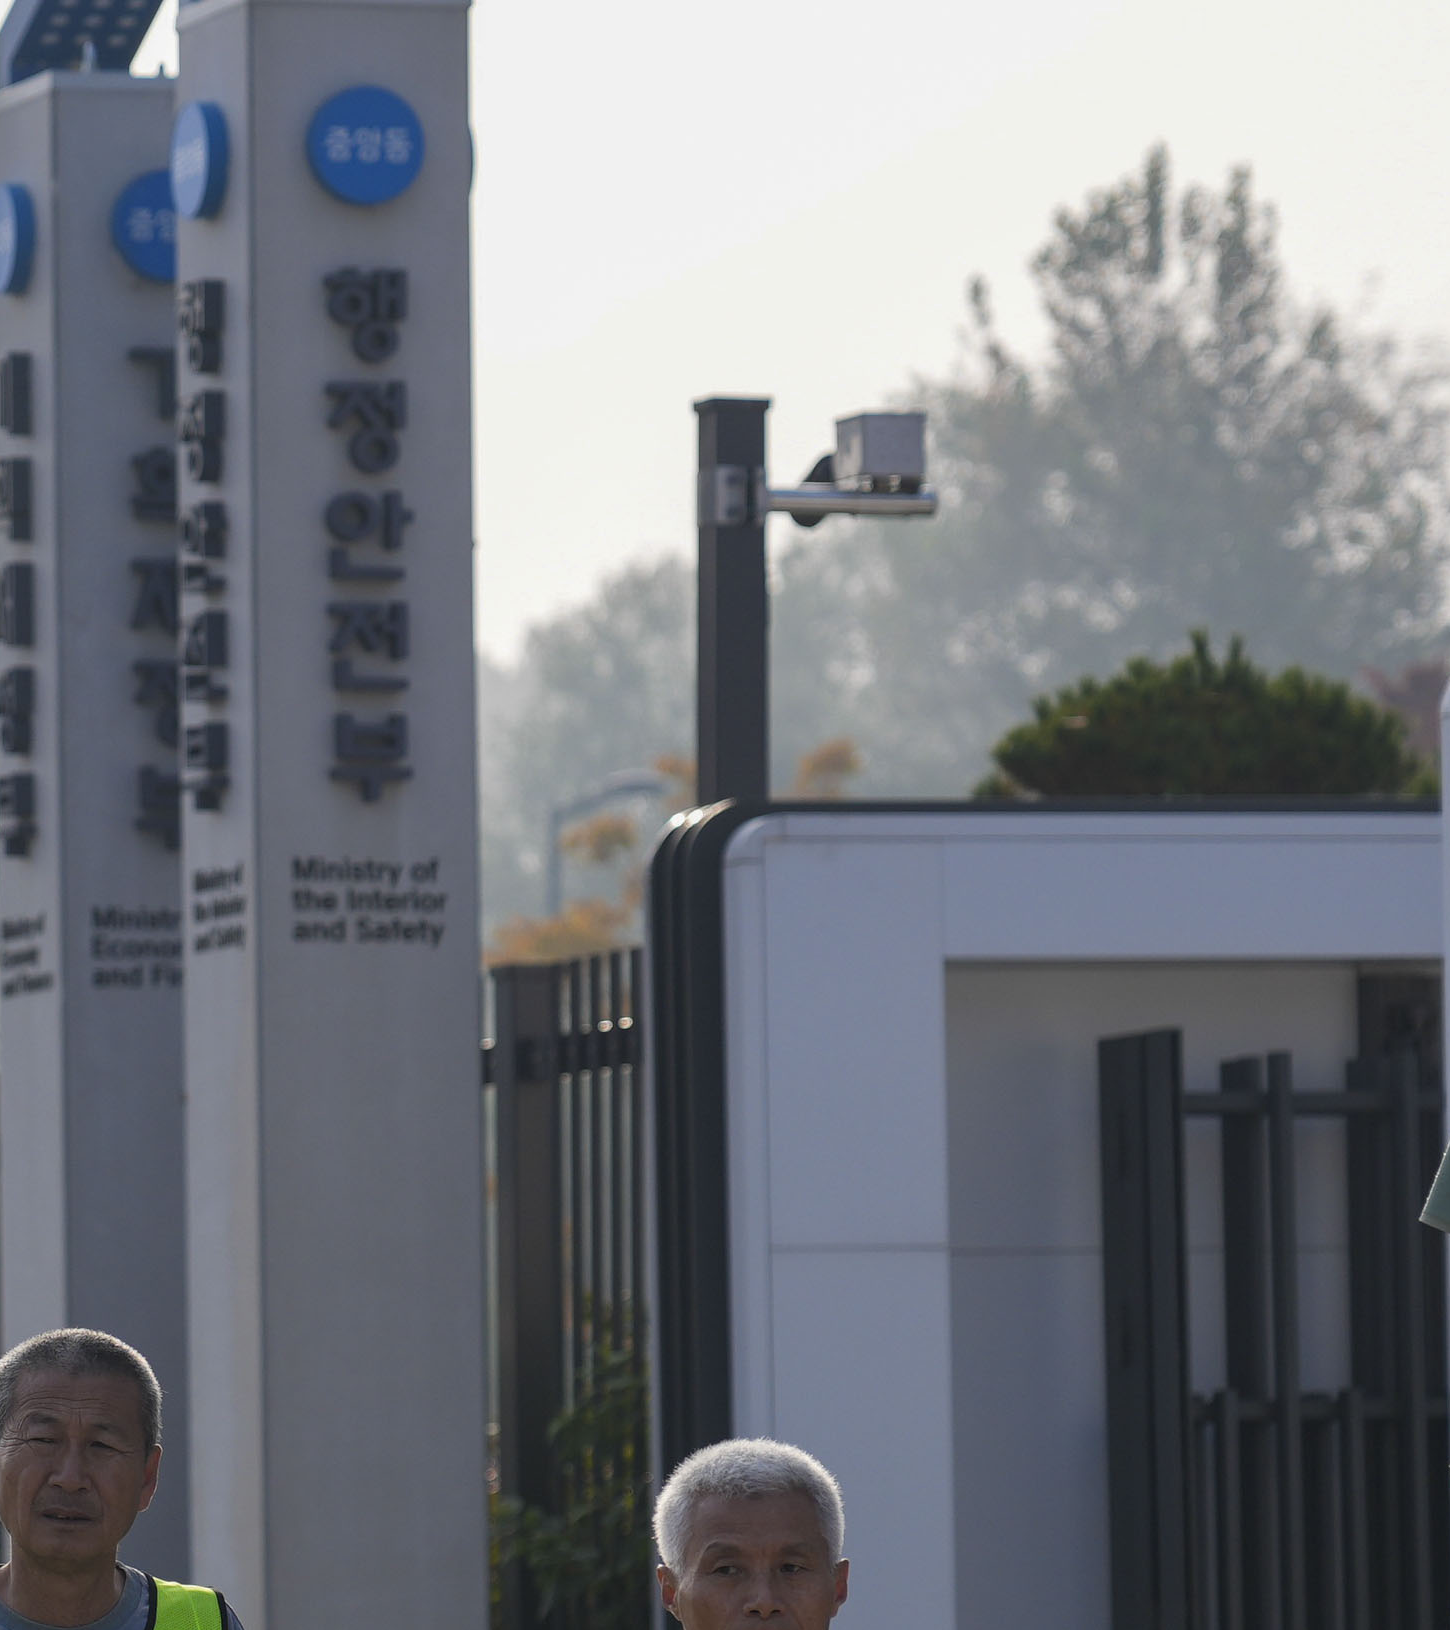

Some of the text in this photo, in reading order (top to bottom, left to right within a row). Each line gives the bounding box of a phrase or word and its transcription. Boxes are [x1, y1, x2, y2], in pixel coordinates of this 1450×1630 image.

[324, 126, 413, 164] 중앙동
[323, 266, 416, 803] 행정안전부
[292, 856, 439, 887] Ministry of
[293, 889, 447, 912] the Interior
[294, 917, 445, 948] and Safety
